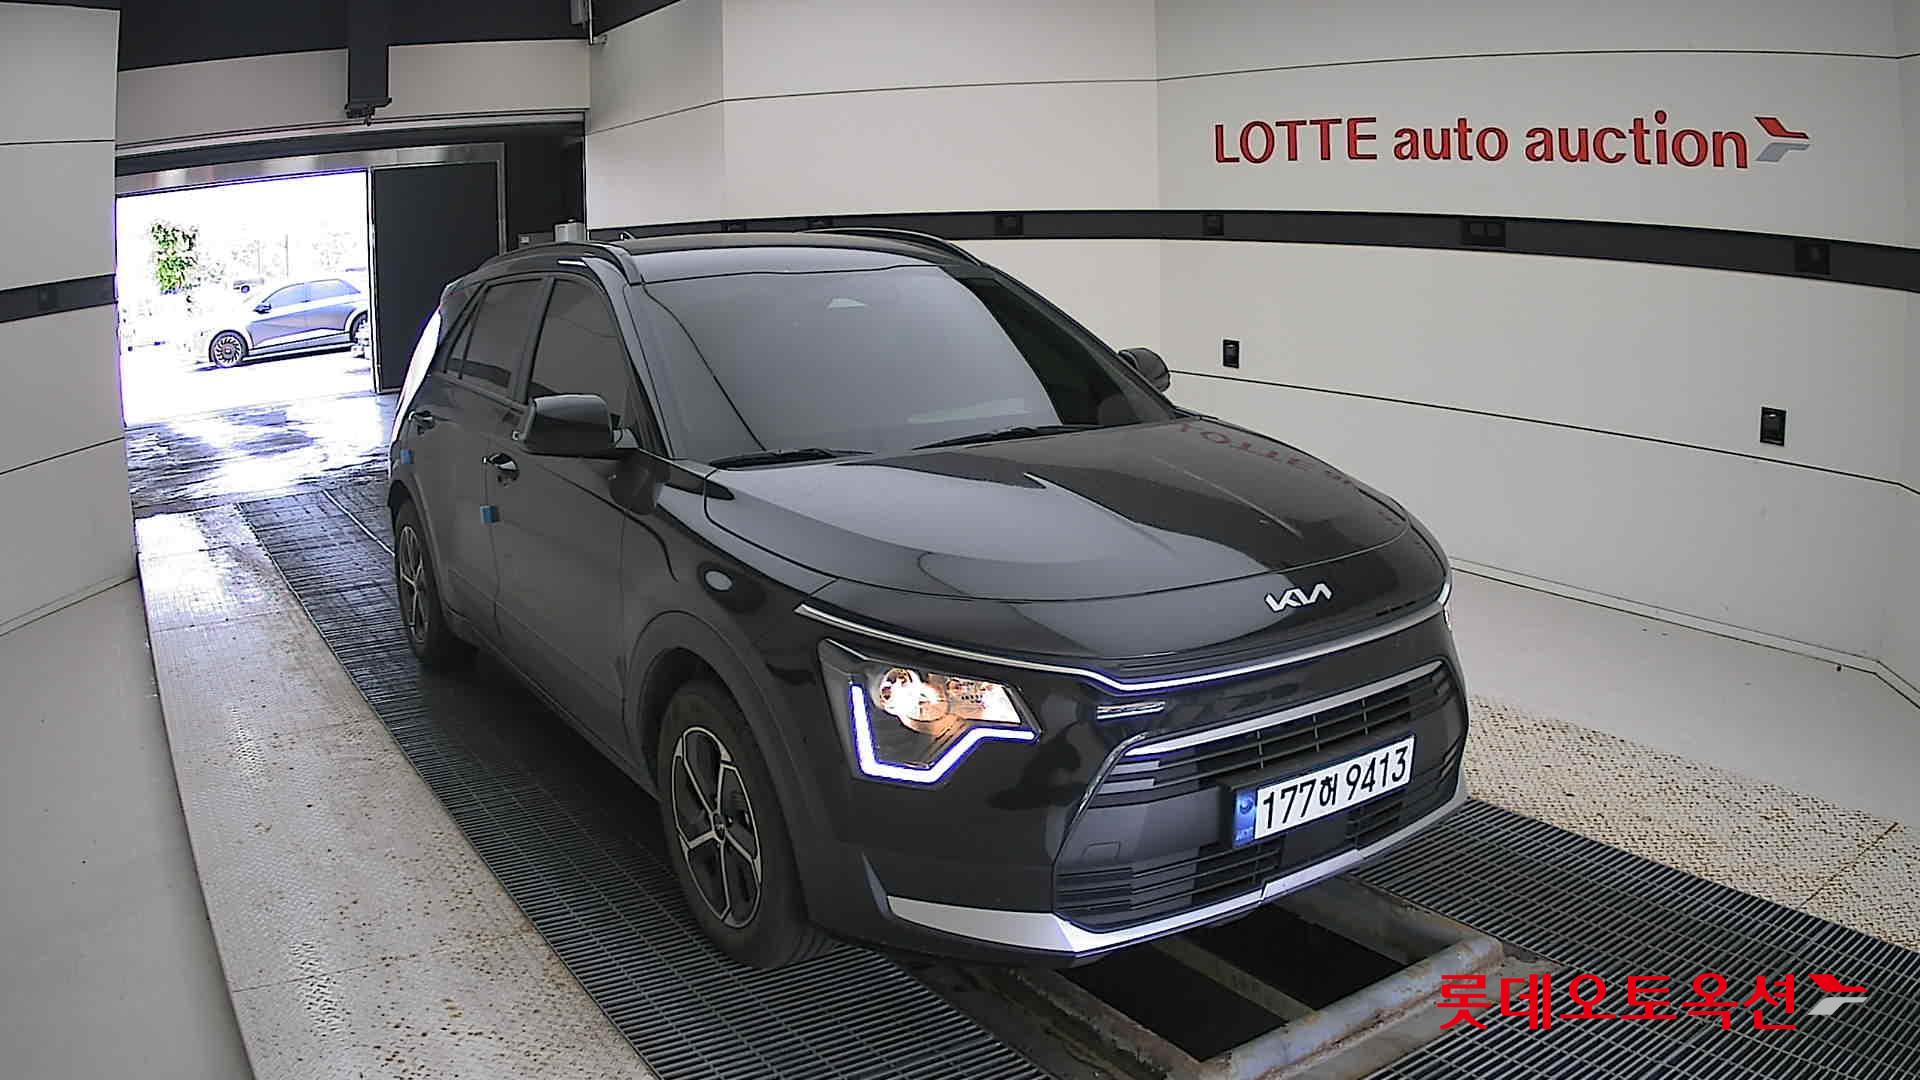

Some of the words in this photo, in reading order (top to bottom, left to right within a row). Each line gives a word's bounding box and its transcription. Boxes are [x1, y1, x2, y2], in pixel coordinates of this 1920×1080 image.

[1214, 116, 1378, 165] LOTTE
[1392, 117, 1509, 162] auto
[1524, 109, 1750, 170] auction
[1265, 583, 1333, 612] KIA
[1262, 772, 1339, 830] 177허
[1345, 745, 1410, 801] 9413
